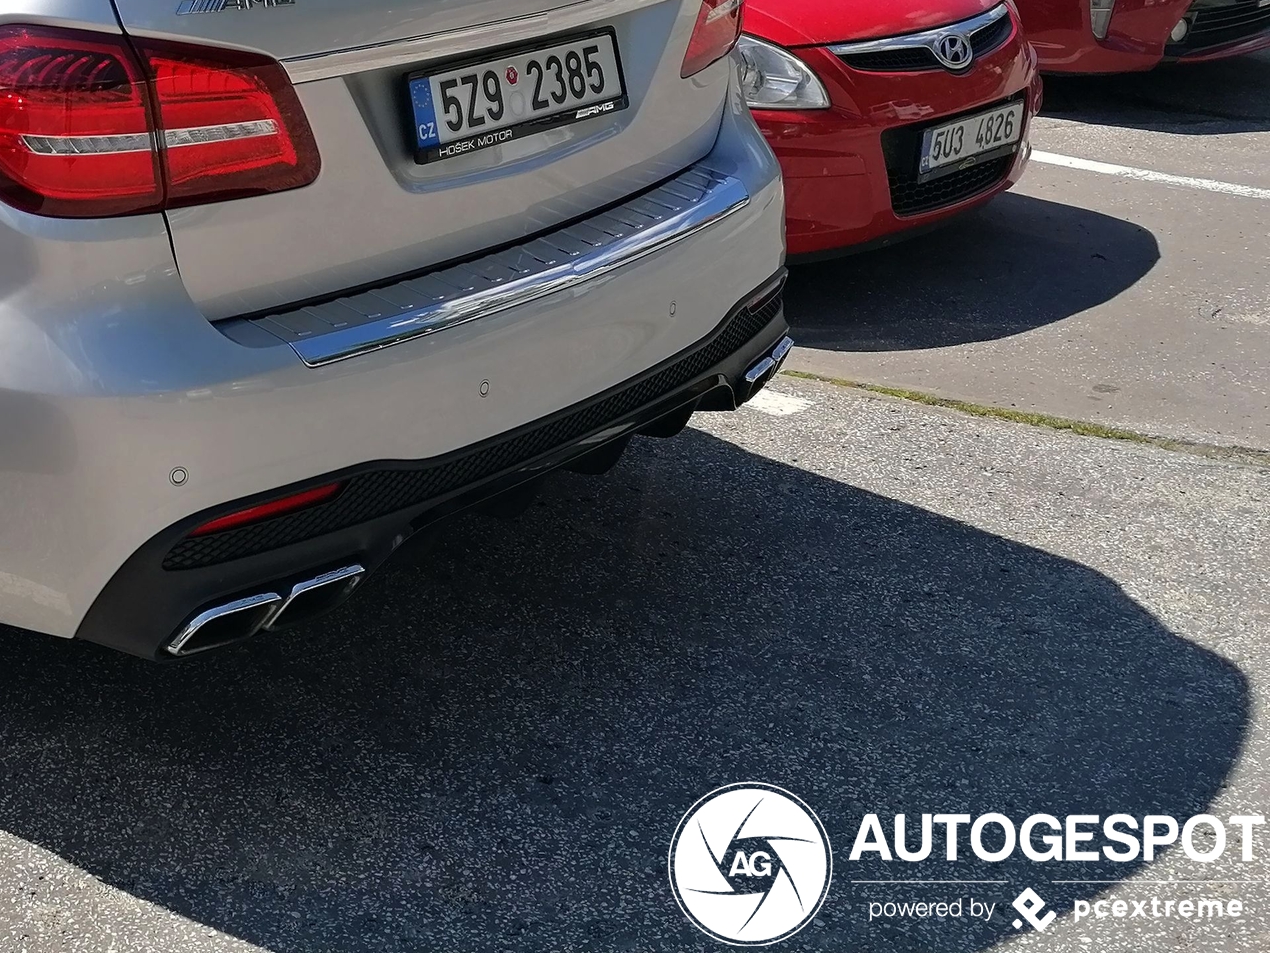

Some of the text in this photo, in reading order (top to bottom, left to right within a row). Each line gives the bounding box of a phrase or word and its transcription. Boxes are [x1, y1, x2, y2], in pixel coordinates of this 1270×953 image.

[439, 45, 605, 132] 5Z9 2385
[419, 123, 436, 140] CZ
[439, 129, 513, 157] HOŠEK MOTOR
[932, 110, 1015, 161] 5U3 4826
